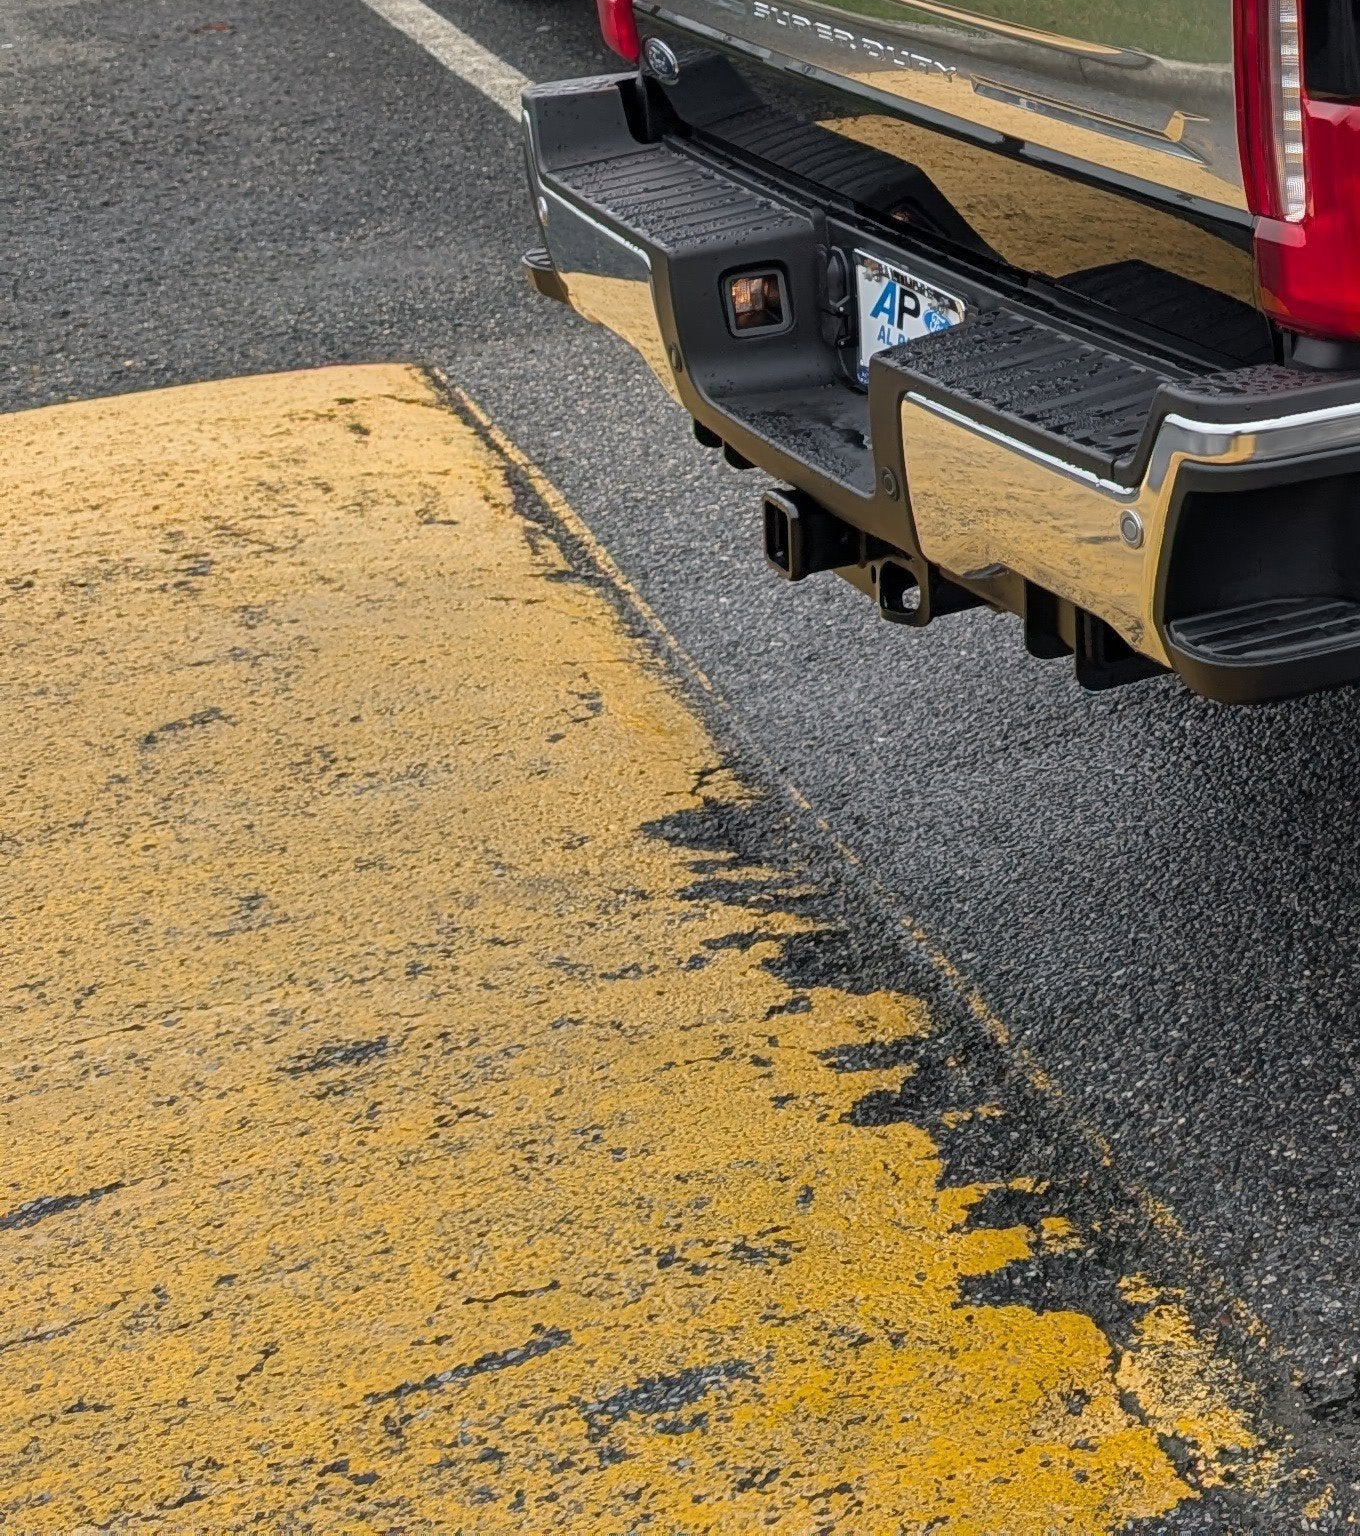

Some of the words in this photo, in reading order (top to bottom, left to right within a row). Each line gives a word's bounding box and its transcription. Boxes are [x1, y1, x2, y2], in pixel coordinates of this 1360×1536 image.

[753, 0, 857, 51] SUPER
[861, 37, 957, 83] DUTY
[869, 280, 921, 331] AP
[877, 325, 893, 346] AL
